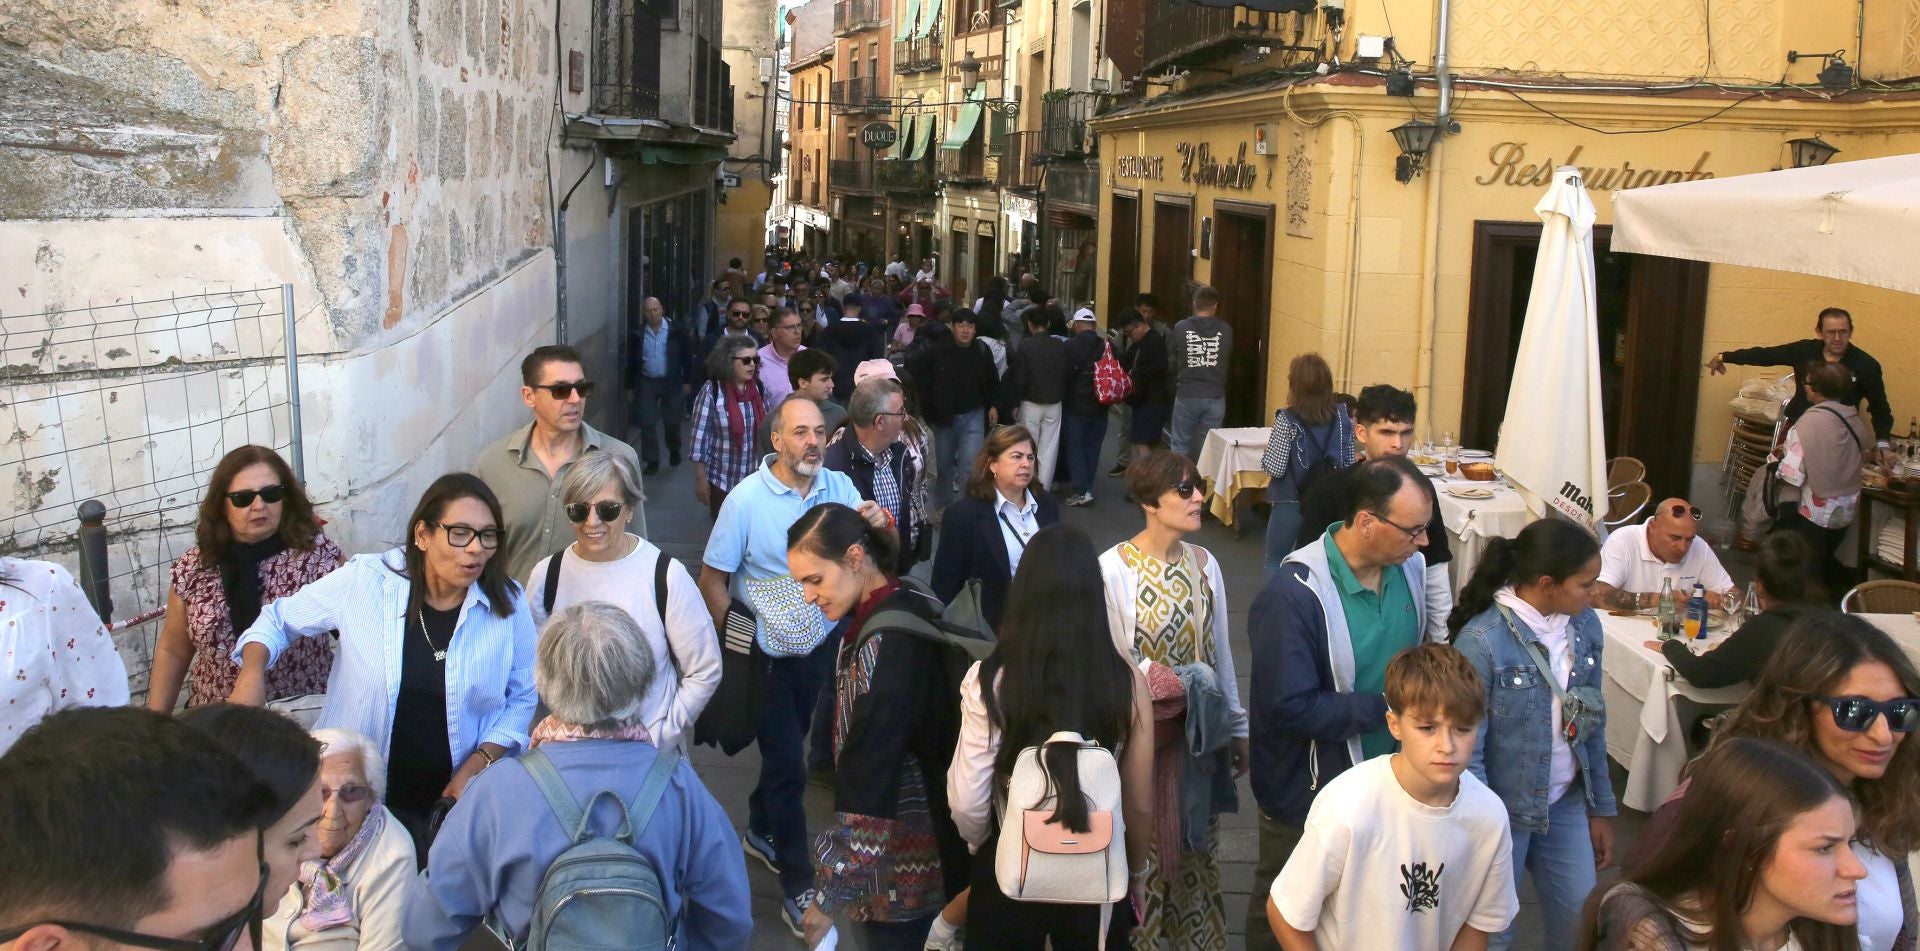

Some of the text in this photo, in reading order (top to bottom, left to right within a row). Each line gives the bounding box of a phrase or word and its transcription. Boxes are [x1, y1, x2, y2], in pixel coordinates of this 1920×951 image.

[864, 130, 896, 142] DUQUE
[1118, 155, 1163, 181] RESTAURANTE
[1553, 497, 1583, 520] DESDE
[1560, 481, 1593, 514] Mah
